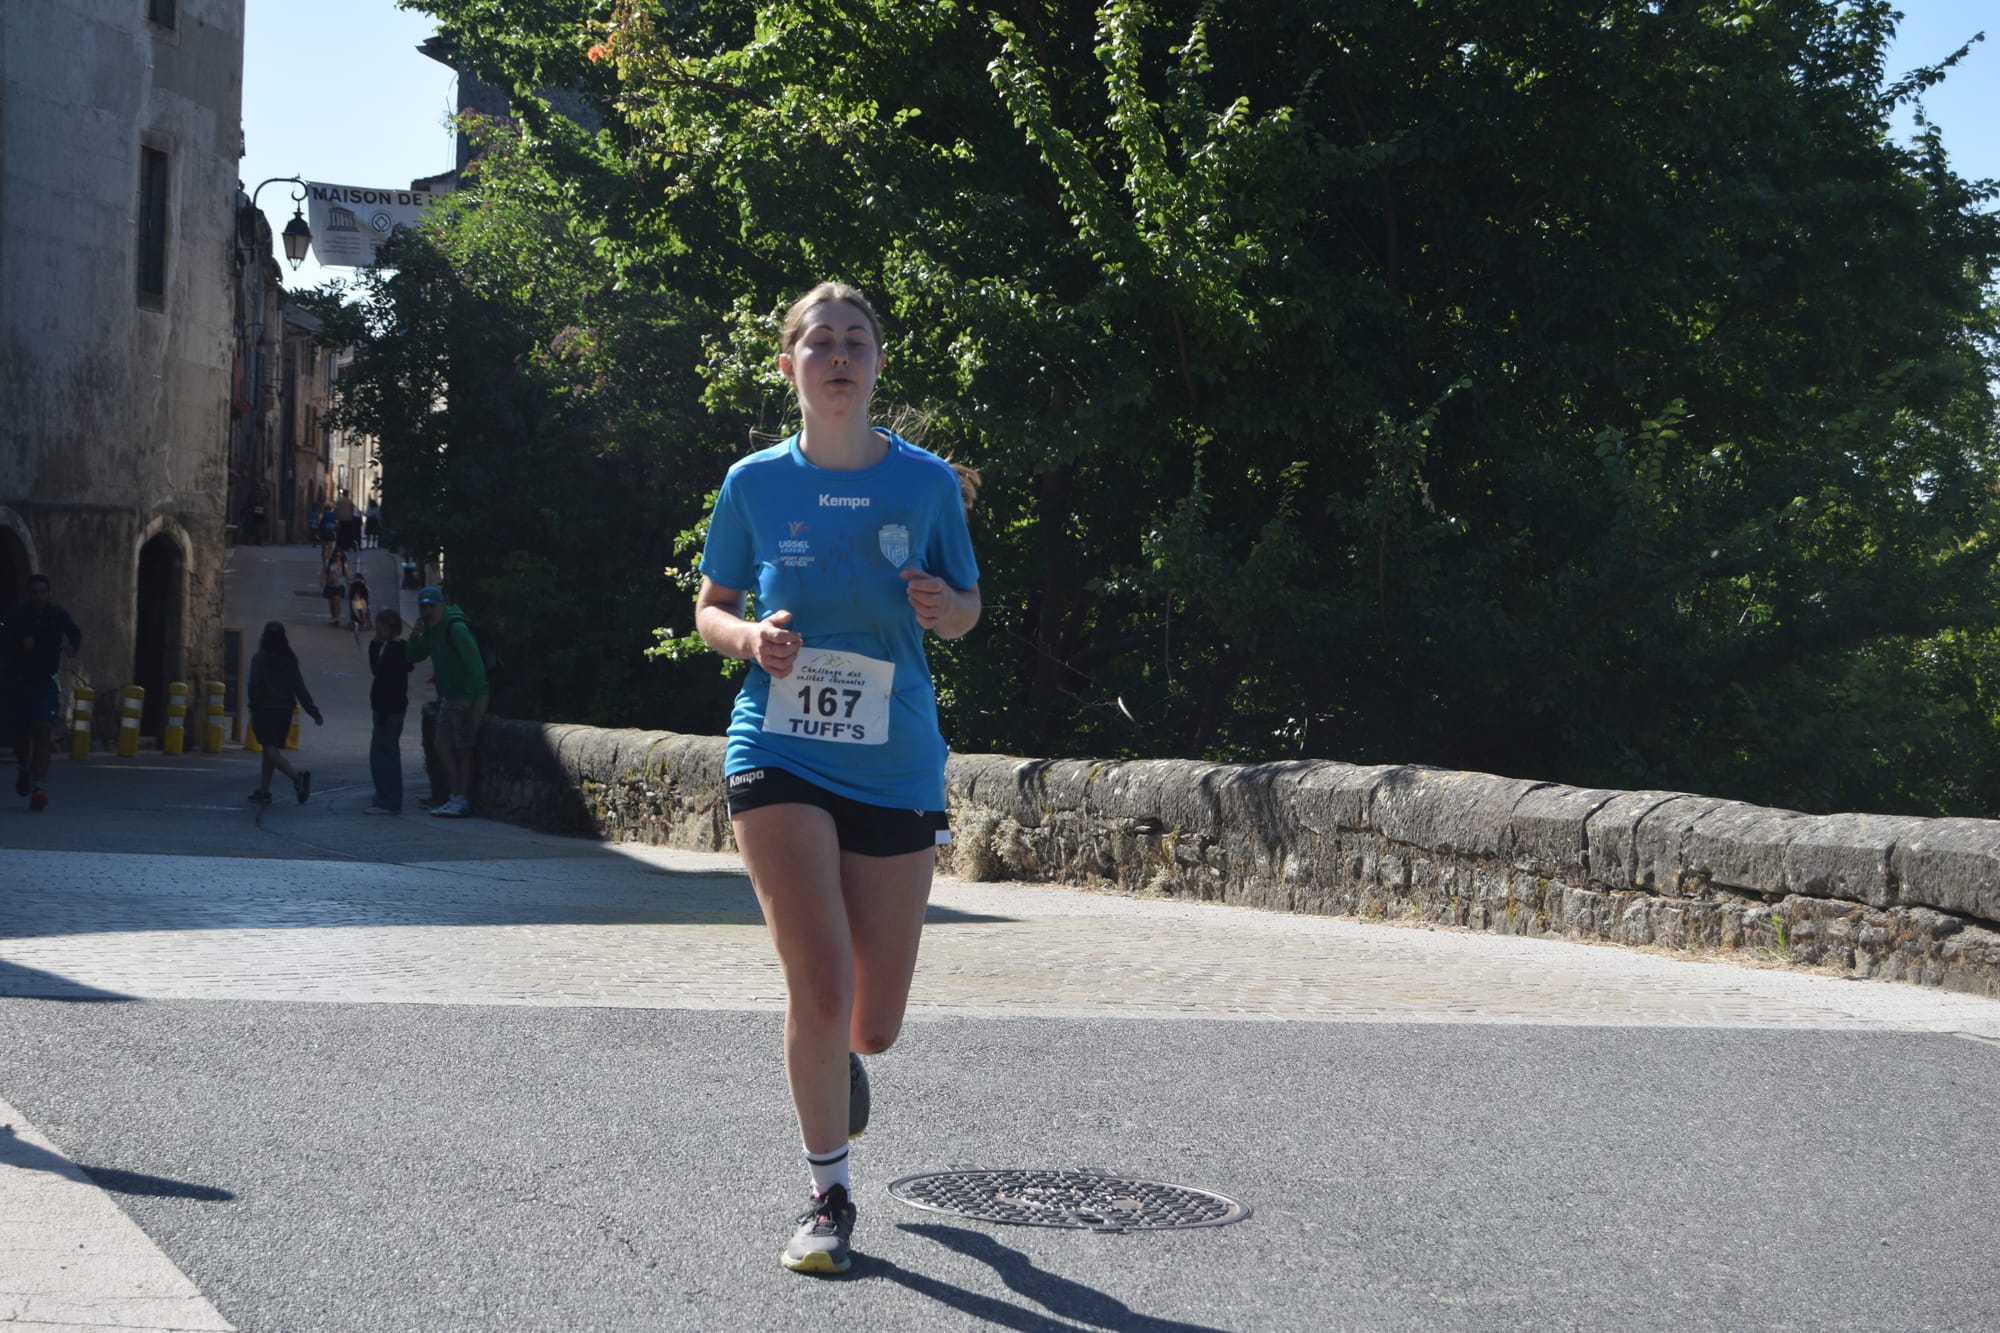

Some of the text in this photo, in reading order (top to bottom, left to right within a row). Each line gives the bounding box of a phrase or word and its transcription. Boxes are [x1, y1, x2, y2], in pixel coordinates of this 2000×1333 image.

[312, 186, 391, 205] MAISON
[398, 192, 422, 206] DE
[818, 494, 870, 510] Kempa
[801, 666, 842, 677] Challenge
[798, 685, 862, 718] 167
[788, 718, 865, 740] TUFF'S
[729, 770, 764, 788] Kempa
